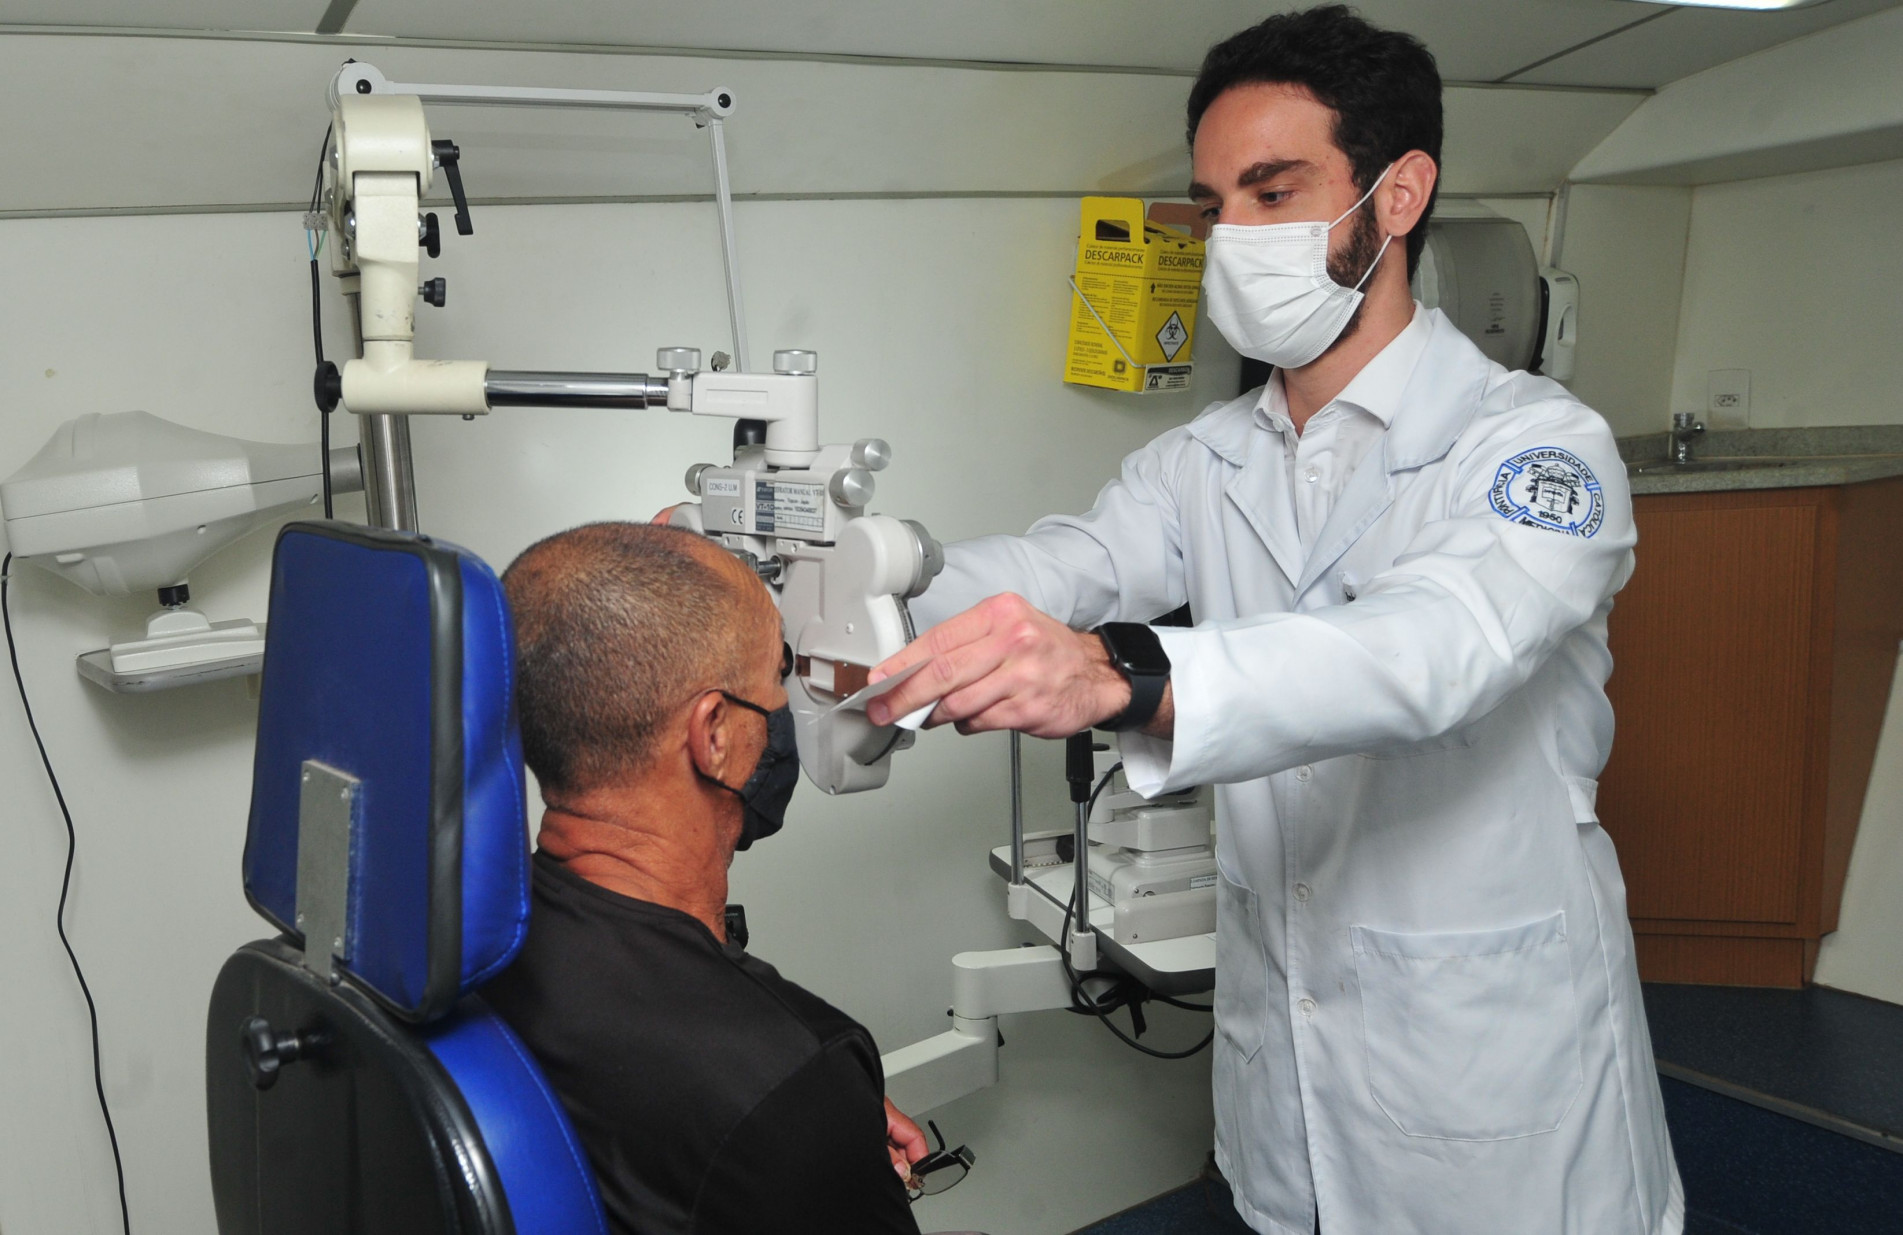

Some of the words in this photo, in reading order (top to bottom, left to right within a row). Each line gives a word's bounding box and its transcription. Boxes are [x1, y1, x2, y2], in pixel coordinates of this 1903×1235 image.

[1085, 249, 1144, 264] DESCARPACK
[1158, 255, 1204, 268] DESCARPACK
[1513, 450, 1594, 483] UNIVERSIDADE
[1538, 510, 1563, 524] 1950
